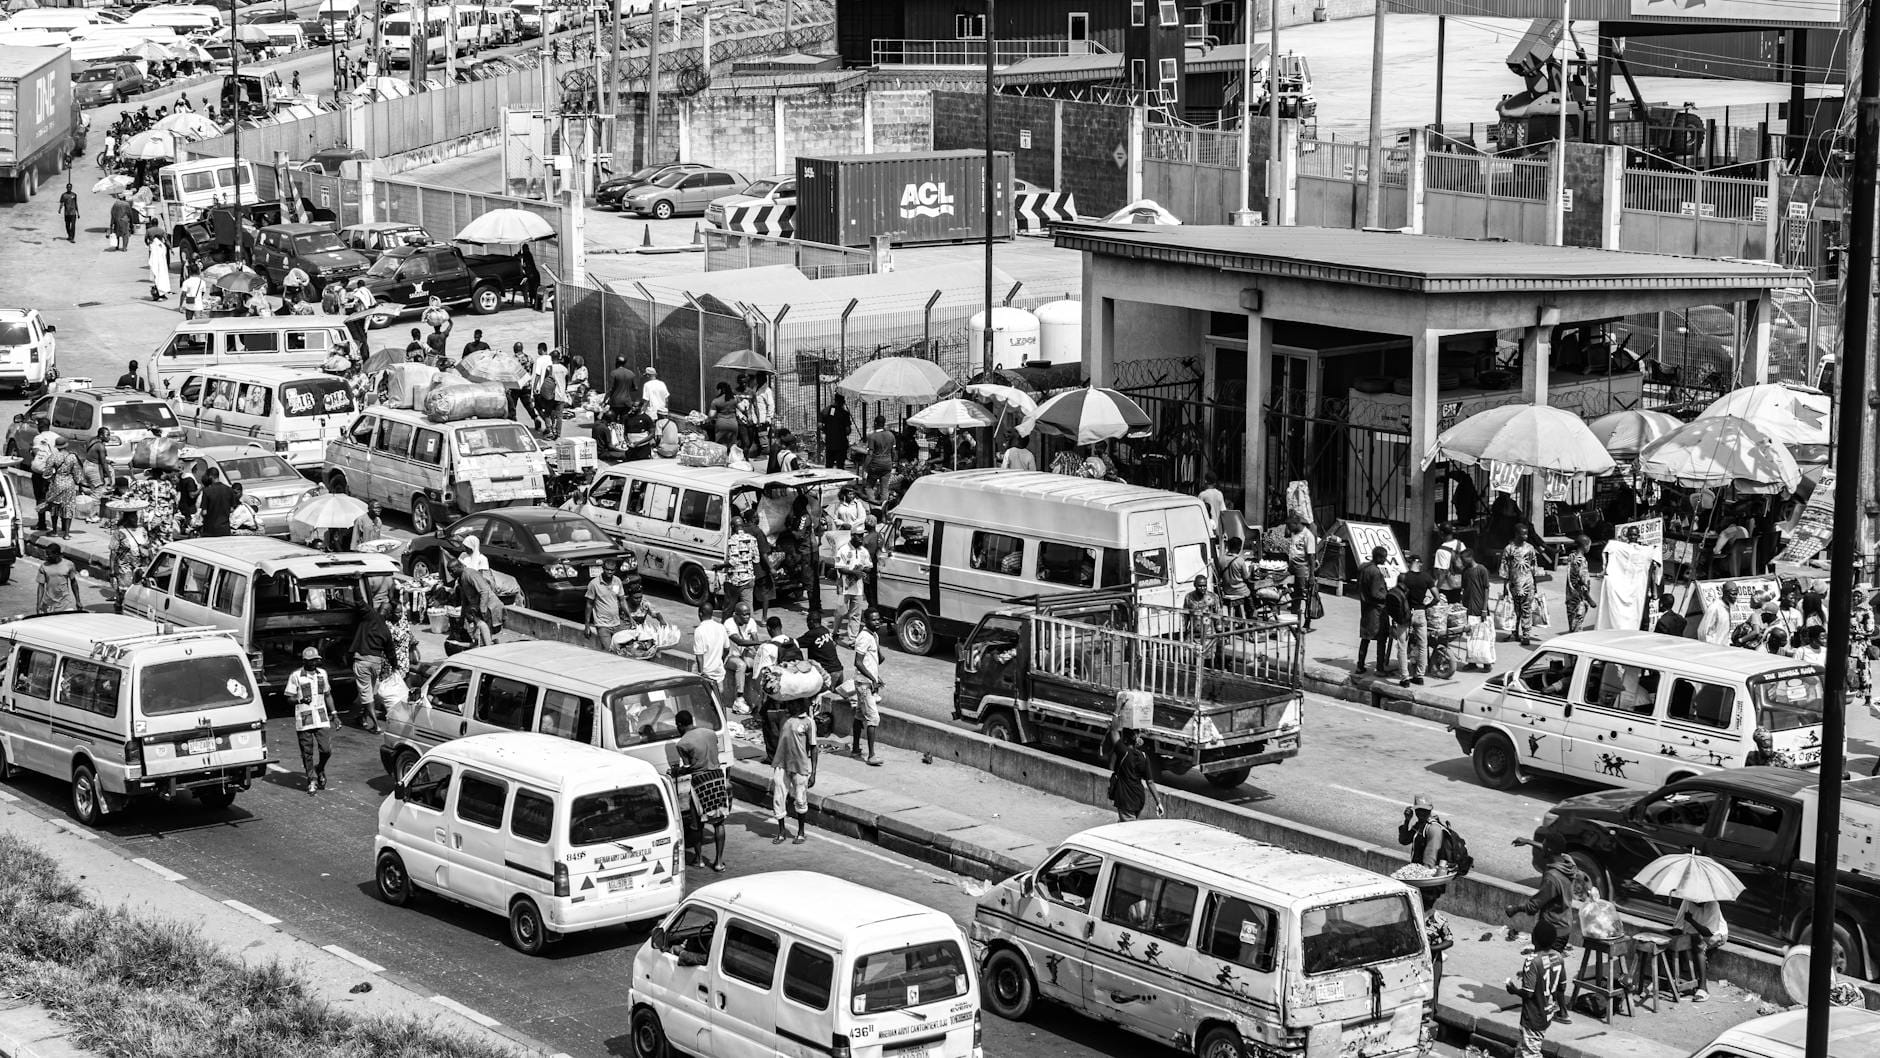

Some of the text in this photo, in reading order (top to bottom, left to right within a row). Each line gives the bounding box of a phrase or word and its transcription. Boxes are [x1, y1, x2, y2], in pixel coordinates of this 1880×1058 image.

[36, 70, 55, 125] ONE
[900, 181, 954, 206] ACL
[1352, 527, 1397, 556] POS
[1543, 964, 1562, 997] 17
[950, 1003, 973, 1013] EVERY
